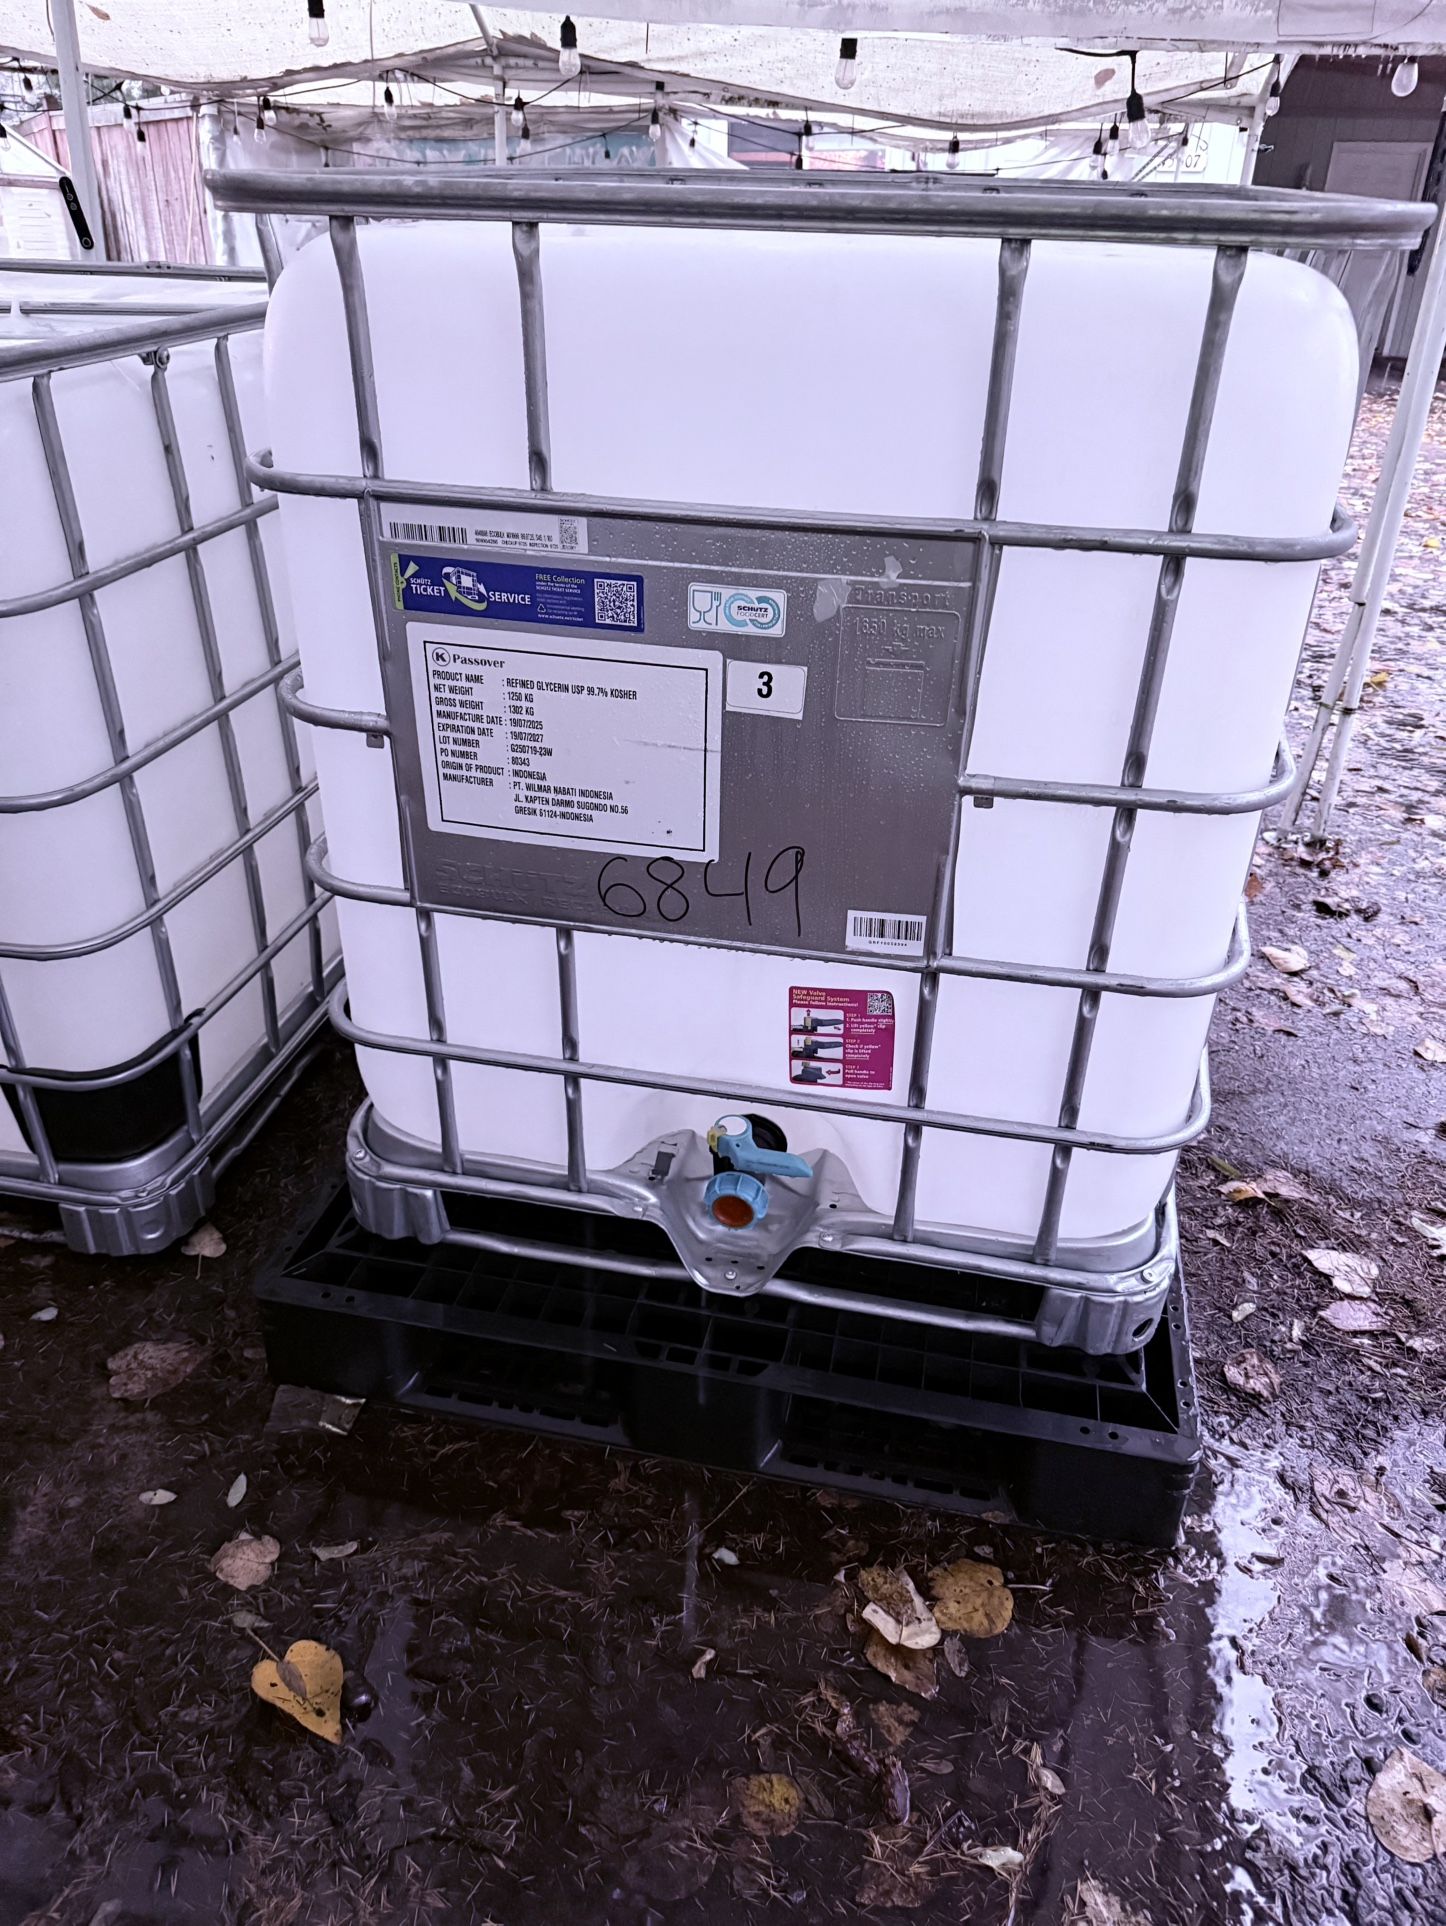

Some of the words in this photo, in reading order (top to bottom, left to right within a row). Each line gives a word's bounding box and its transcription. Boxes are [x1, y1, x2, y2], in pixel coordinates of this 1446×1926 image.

[536, 573, 551, 581] FREE
[552, 575, 585, 584] Collection
[411, 584, 445, 596] TICKET
[489, 591, 531, 605] SERVICE
[916, 624, 945, 640] max
[452, 653, 506, 669] Passover
[432, 670, 463, 682] PRODUCT
[464, 673, 485, 685] NAME
[506, 678, 535, 690] REFINED
[536, 681, 569, 694] GLYCERIN
[571, 684, 585, 695] USP
[586, 686, 608, 698] 99.7%
[610, 688, 638, 700] KOSHER
[433, 683, 446, 693] NET
[448, 684, 473, 697] WEIGHT
[507, 692, 523, 702] 1250
[524, 692, 534, 703] KG
[756, 671, 774, 699] 3
[435, 696, 457, 708] GROSS
[458, 699, 484, 711] WEIGHT
[508, 705, 523, 715] 1302
[525, 706, 535, 716] KG
[436, 709, 484, 724] MANUFACTURE
[486, 716, 503, 726] DATE
[509, 718, 543, 730] 19/07/2025
[437, 722, 475, 735] EXPIRATION
[477, 727, 494, 738] DATE
[510, 730, 544, 743] 19/07/2027
[438, 735, 451, 745] LOT
[452, 736, 480, 749] NUMBER
[510, 743, 553, 757] G250719-23W
[440, 747, 449, 757] PO
[450, 748, 479, 761] NUMBER
[441, 760, 463, 771] ORIGIN
[465, 763, 474, 772] OF
[475, 764, 504, 776] PRODUCT
[512, 768, 547, 782] INDONESIA
[442, 772, 494, 787] MANUFACTURER
[513, 781, 524, 791] PT.
[525, 782, 552, 794] WILMAR
[553, 786, 577, 797] NABATI
[578, 788, 614, 801] INDONESIA
[514, 793, 523, 803] JL.
[525, 795, 550, 806] KAPTEN
[551, 797, 575, 809] DARMO
[576, 801, 608, 813] SUGONDO
[609, 804, 629, 815] NO.56
[514, 805, 538, 817] GRESIK
[597, 846, 805, 937] 6849
[793, 994, 825, 1002] Safeguard
